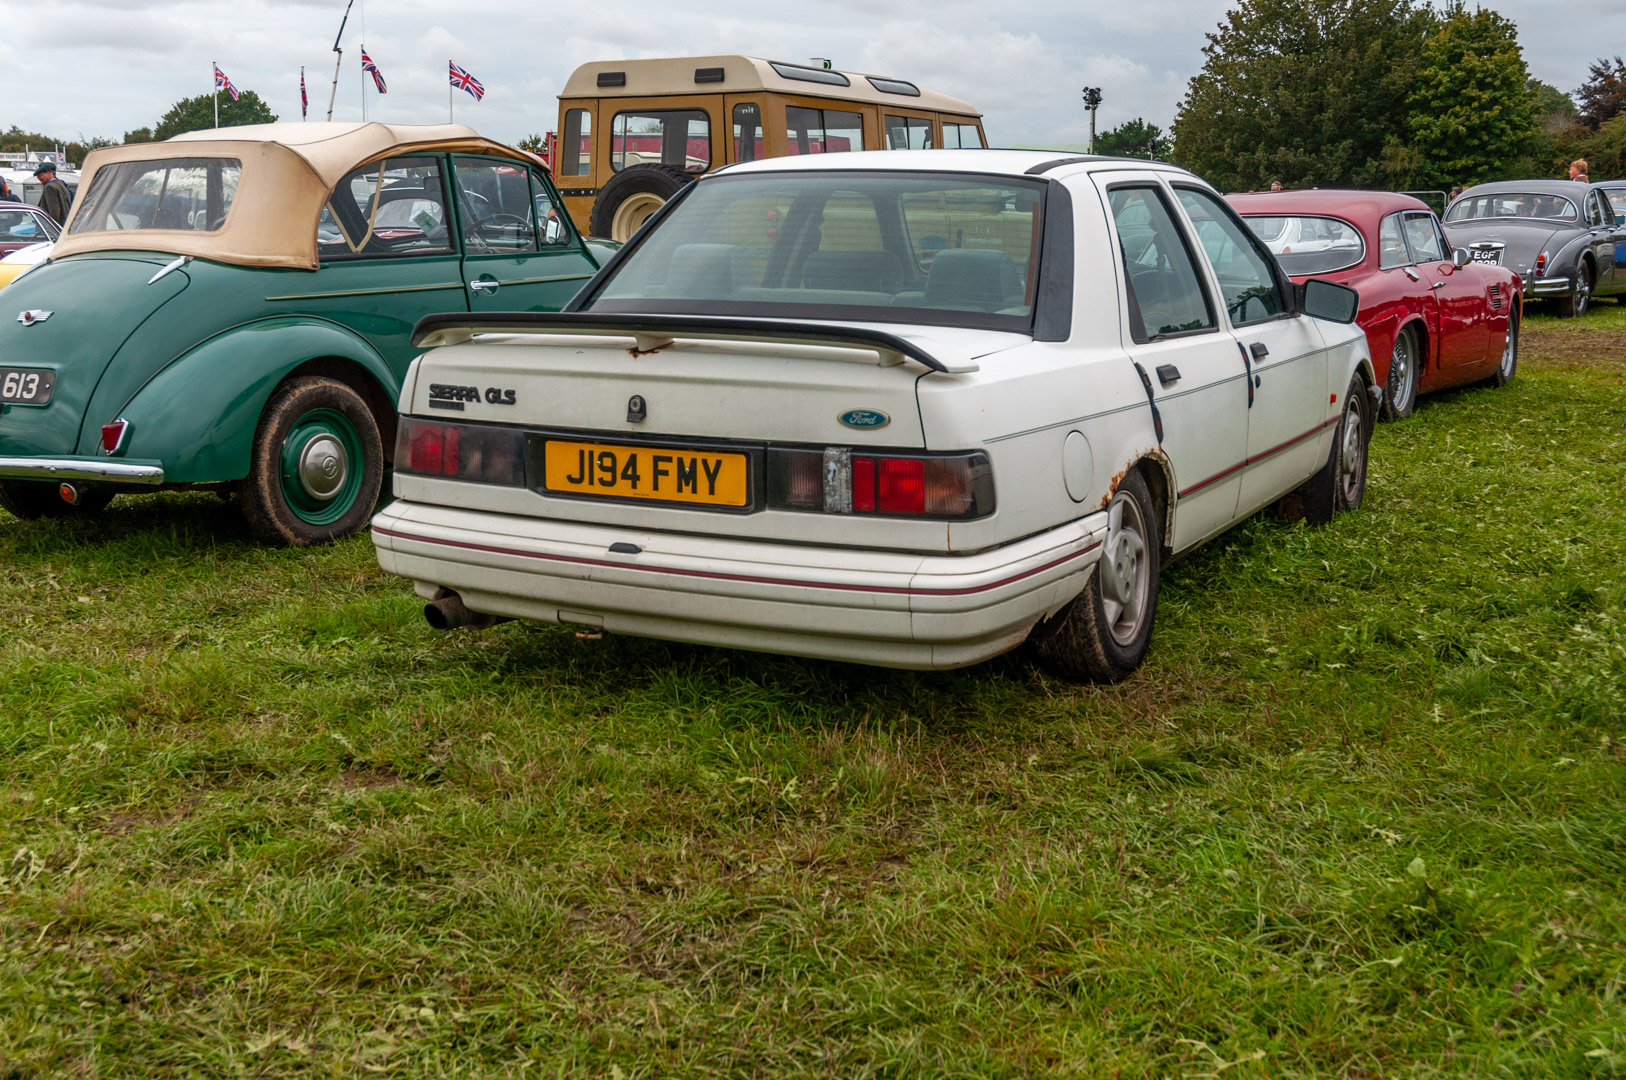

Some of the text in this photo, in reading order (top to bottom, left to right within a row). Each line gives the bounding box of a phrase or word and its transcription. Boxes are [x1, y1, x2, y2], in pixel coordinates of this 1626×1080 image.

[1473, 251, 1496, 259] EGF
[2, 372, 40, 399] 613
[429, 383, 481, 403] SIERRA
[485, 387, 516, 405] GLS
[849, 412, 877, 425] Ford
[566, 449, 723, 496] J194 FMY
